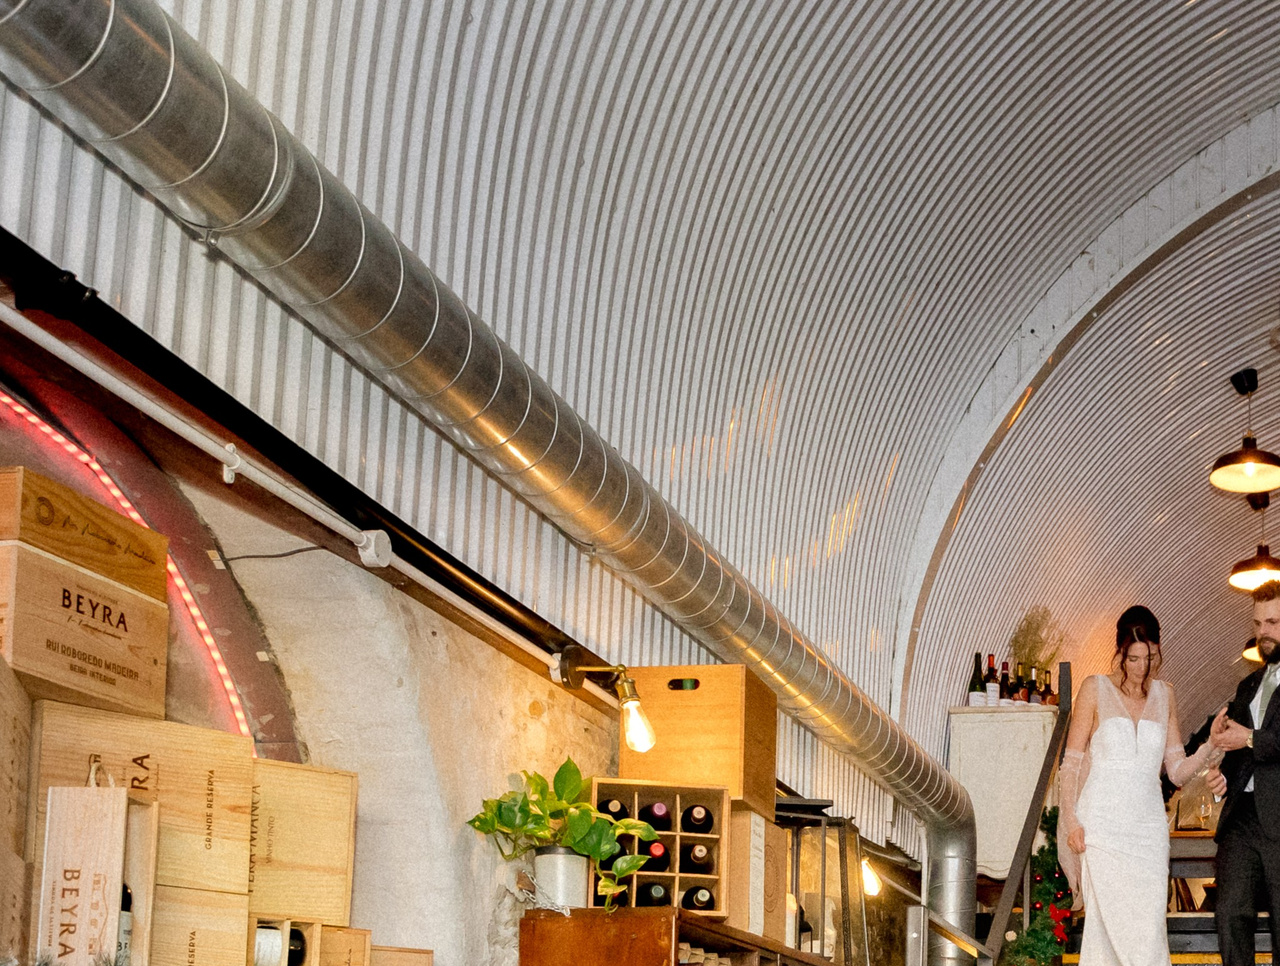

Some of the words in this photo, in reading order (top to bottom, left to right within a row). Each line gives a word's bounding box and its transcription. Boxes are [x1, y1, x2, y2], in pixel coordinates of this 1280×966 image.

[61, 588, 128, 633] BEYRA
[46, 638, 60, 653] RUI
[61, 646, 103, 669] ROBOREDO
[104, 659, 139, 681] MADEIRA
[206, 769, 215, 809] RESERVA
[205, 812, 213, 850] GRANDE
[267, 815, 275, 838] TINTO
[265, 839, 273, 864] VINHO
[58, 869, 81, 959] BEYRA
